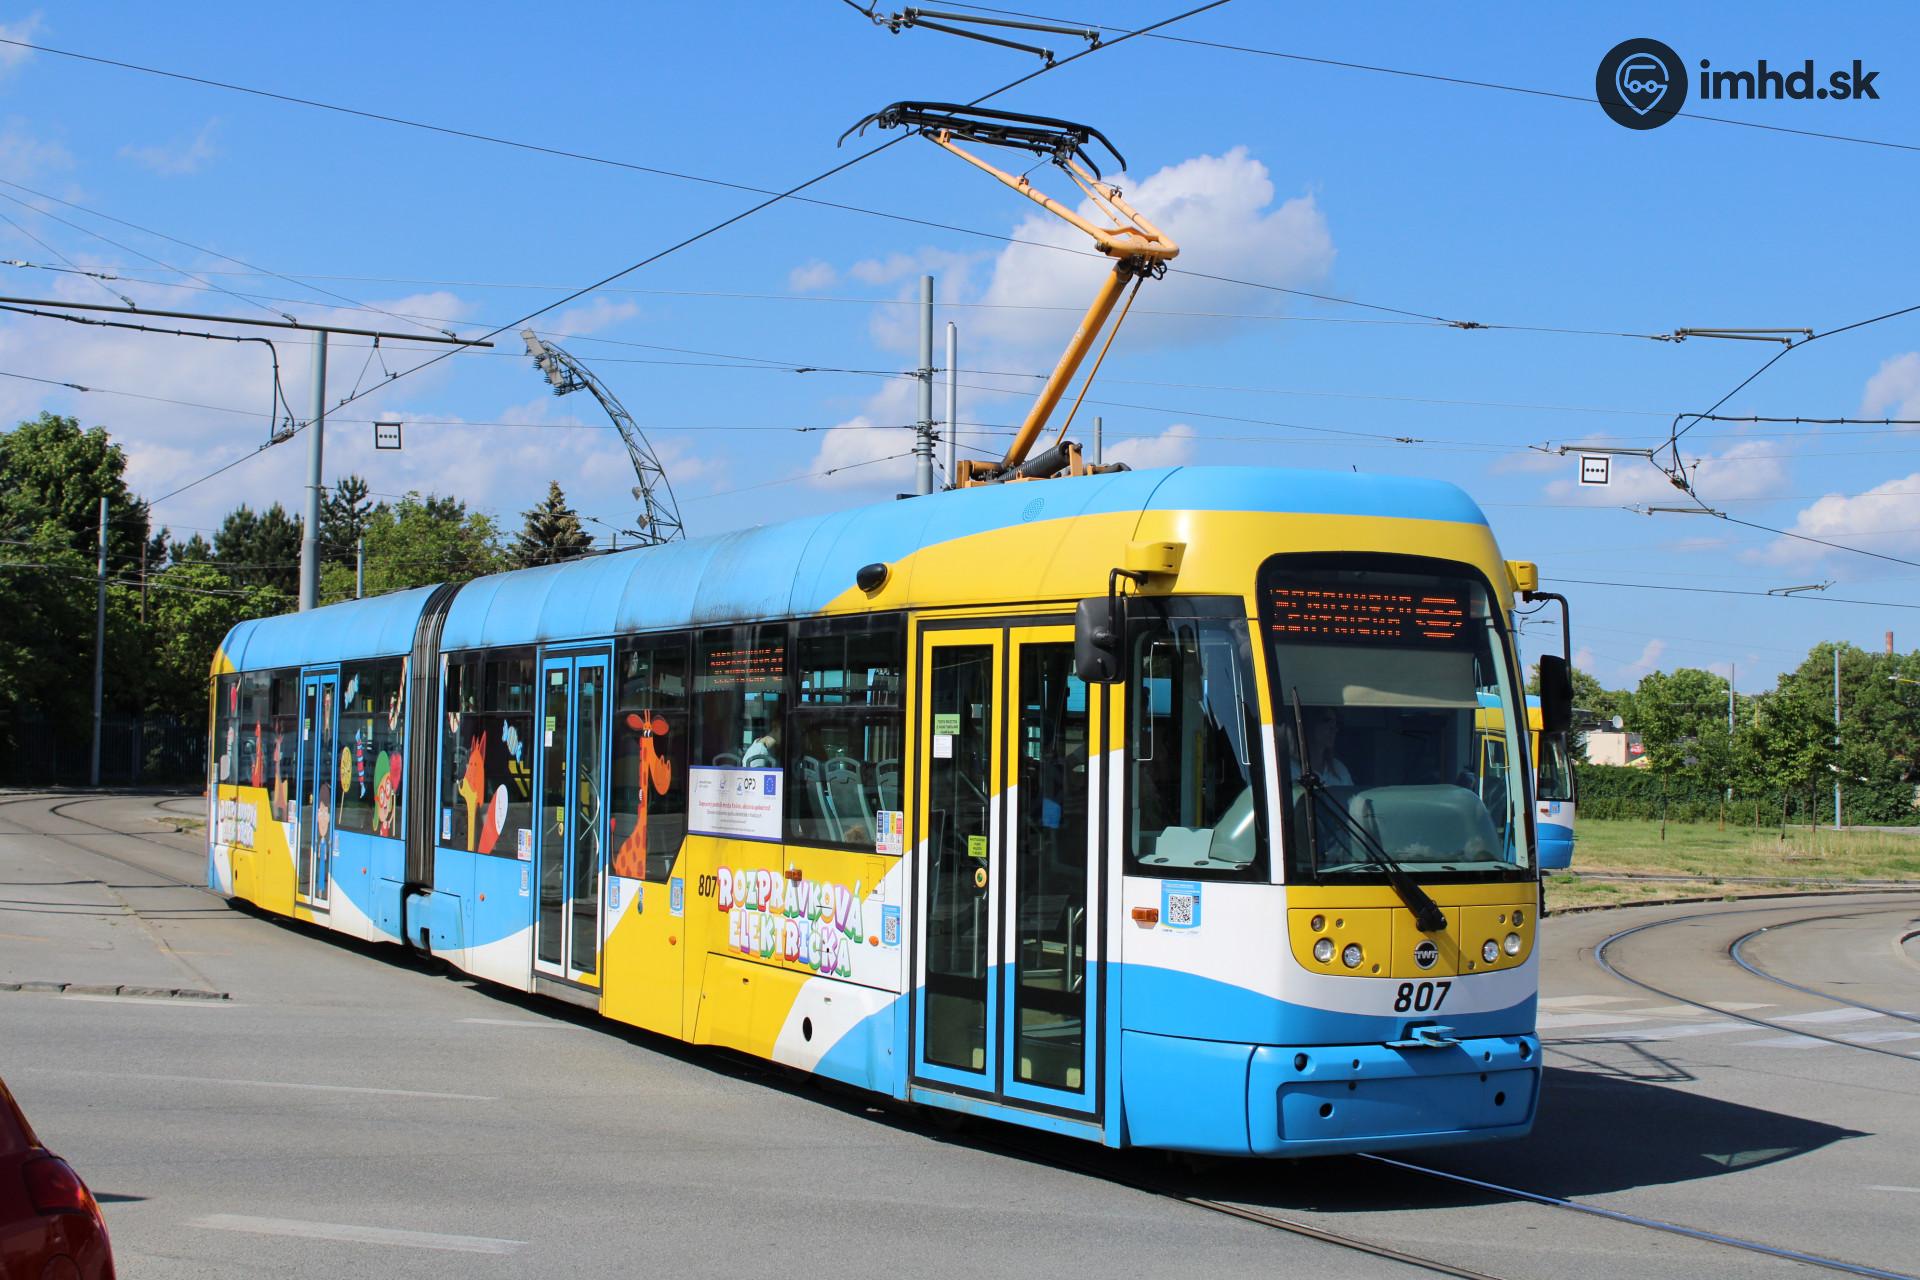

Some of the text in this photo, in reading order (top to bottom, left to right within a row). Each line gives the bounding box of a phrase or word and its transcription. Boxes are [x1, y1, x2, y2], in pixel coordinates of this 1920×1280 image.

[698, 874, 717, 898] 807
[717, 862, 863, 944] ROZPRÁVKOVÁ
[728, 909, 851, 977] ELEKTRIČKA
[1393, 981, 1452, 1013] 807
